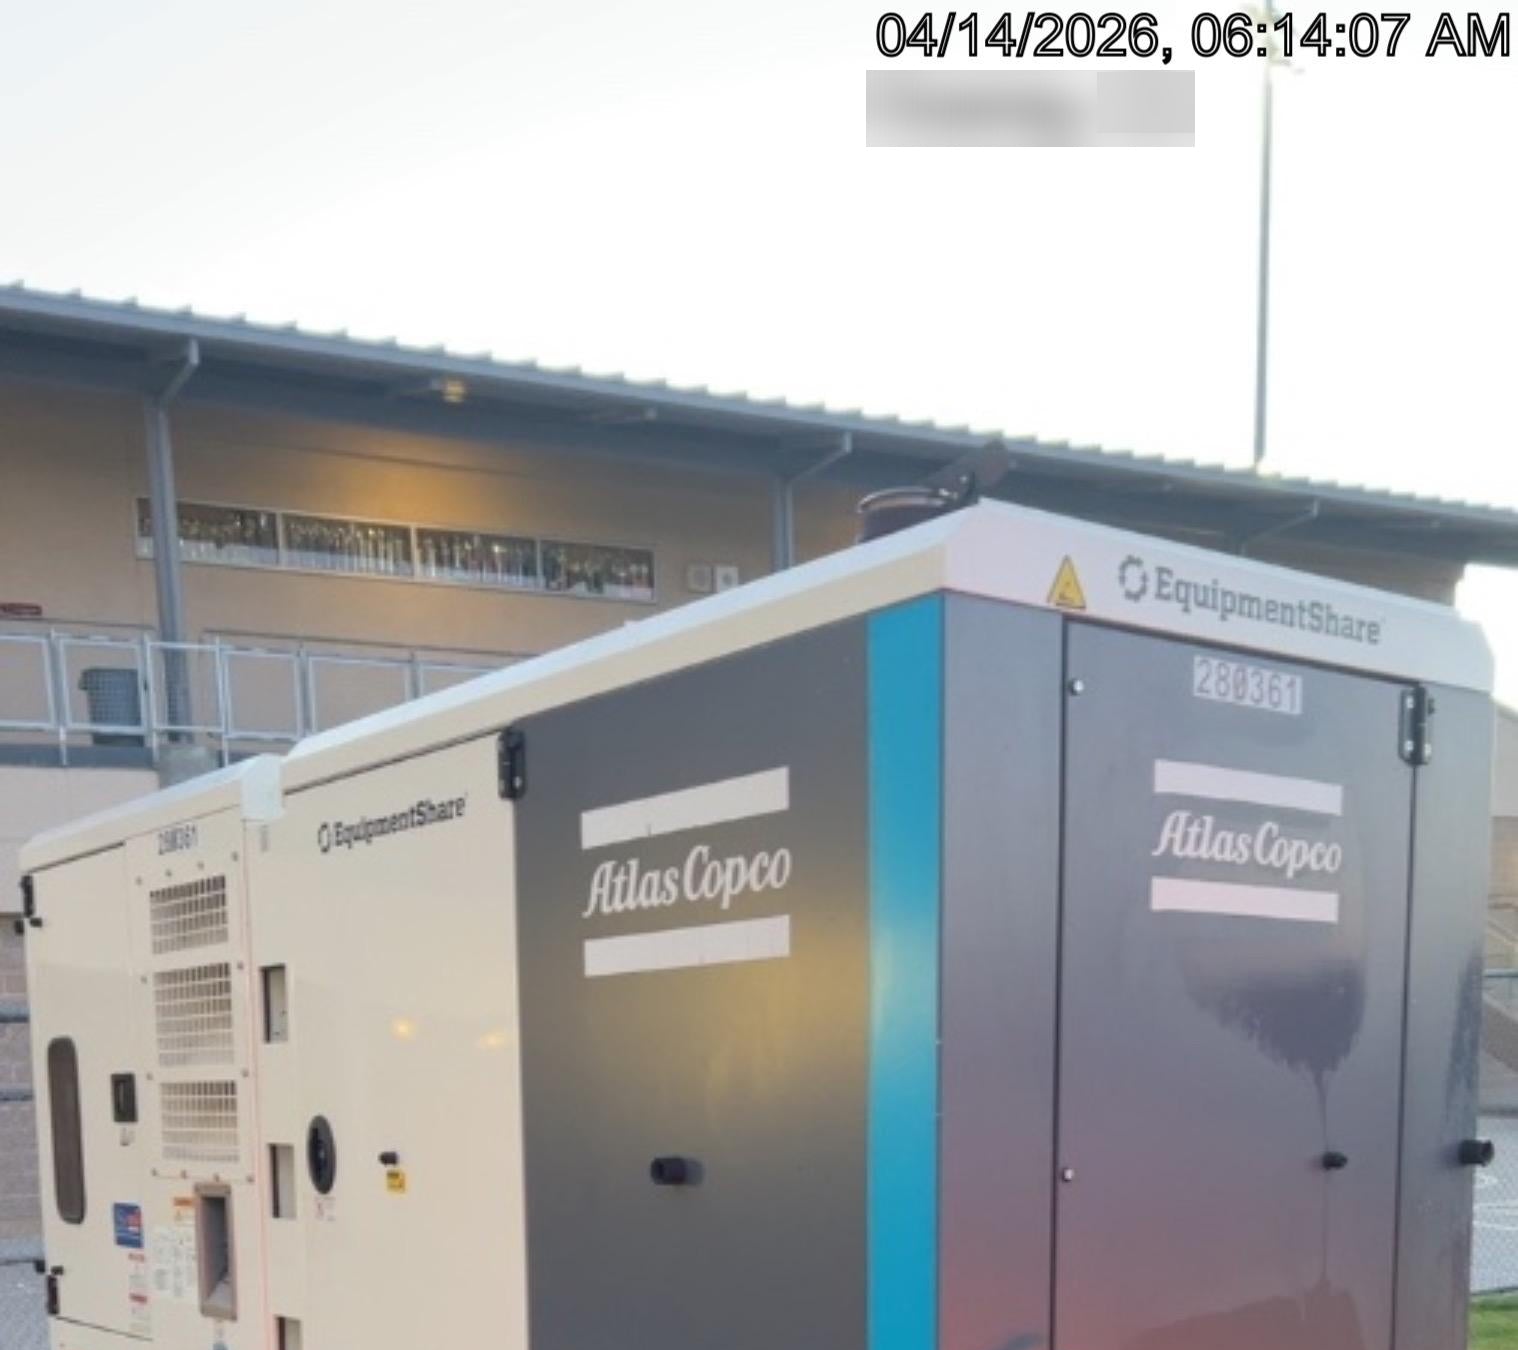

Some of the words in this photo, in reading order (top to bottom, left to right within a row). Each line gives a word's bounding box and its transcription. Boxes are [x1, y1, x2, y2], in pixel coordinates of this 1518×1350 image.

[1154, 566, 1382, 645] EquipmentShare
[1195, 659, 1299, 713] 280361
[333, 797, 466, 849] EquipmentShare
[1151, 809, 1251, 865] Atlas
[1253, 821, 1342, 880] Copco
[582, 857, 680, 918] Atlas
[681, 845, 791, 910] Copco
